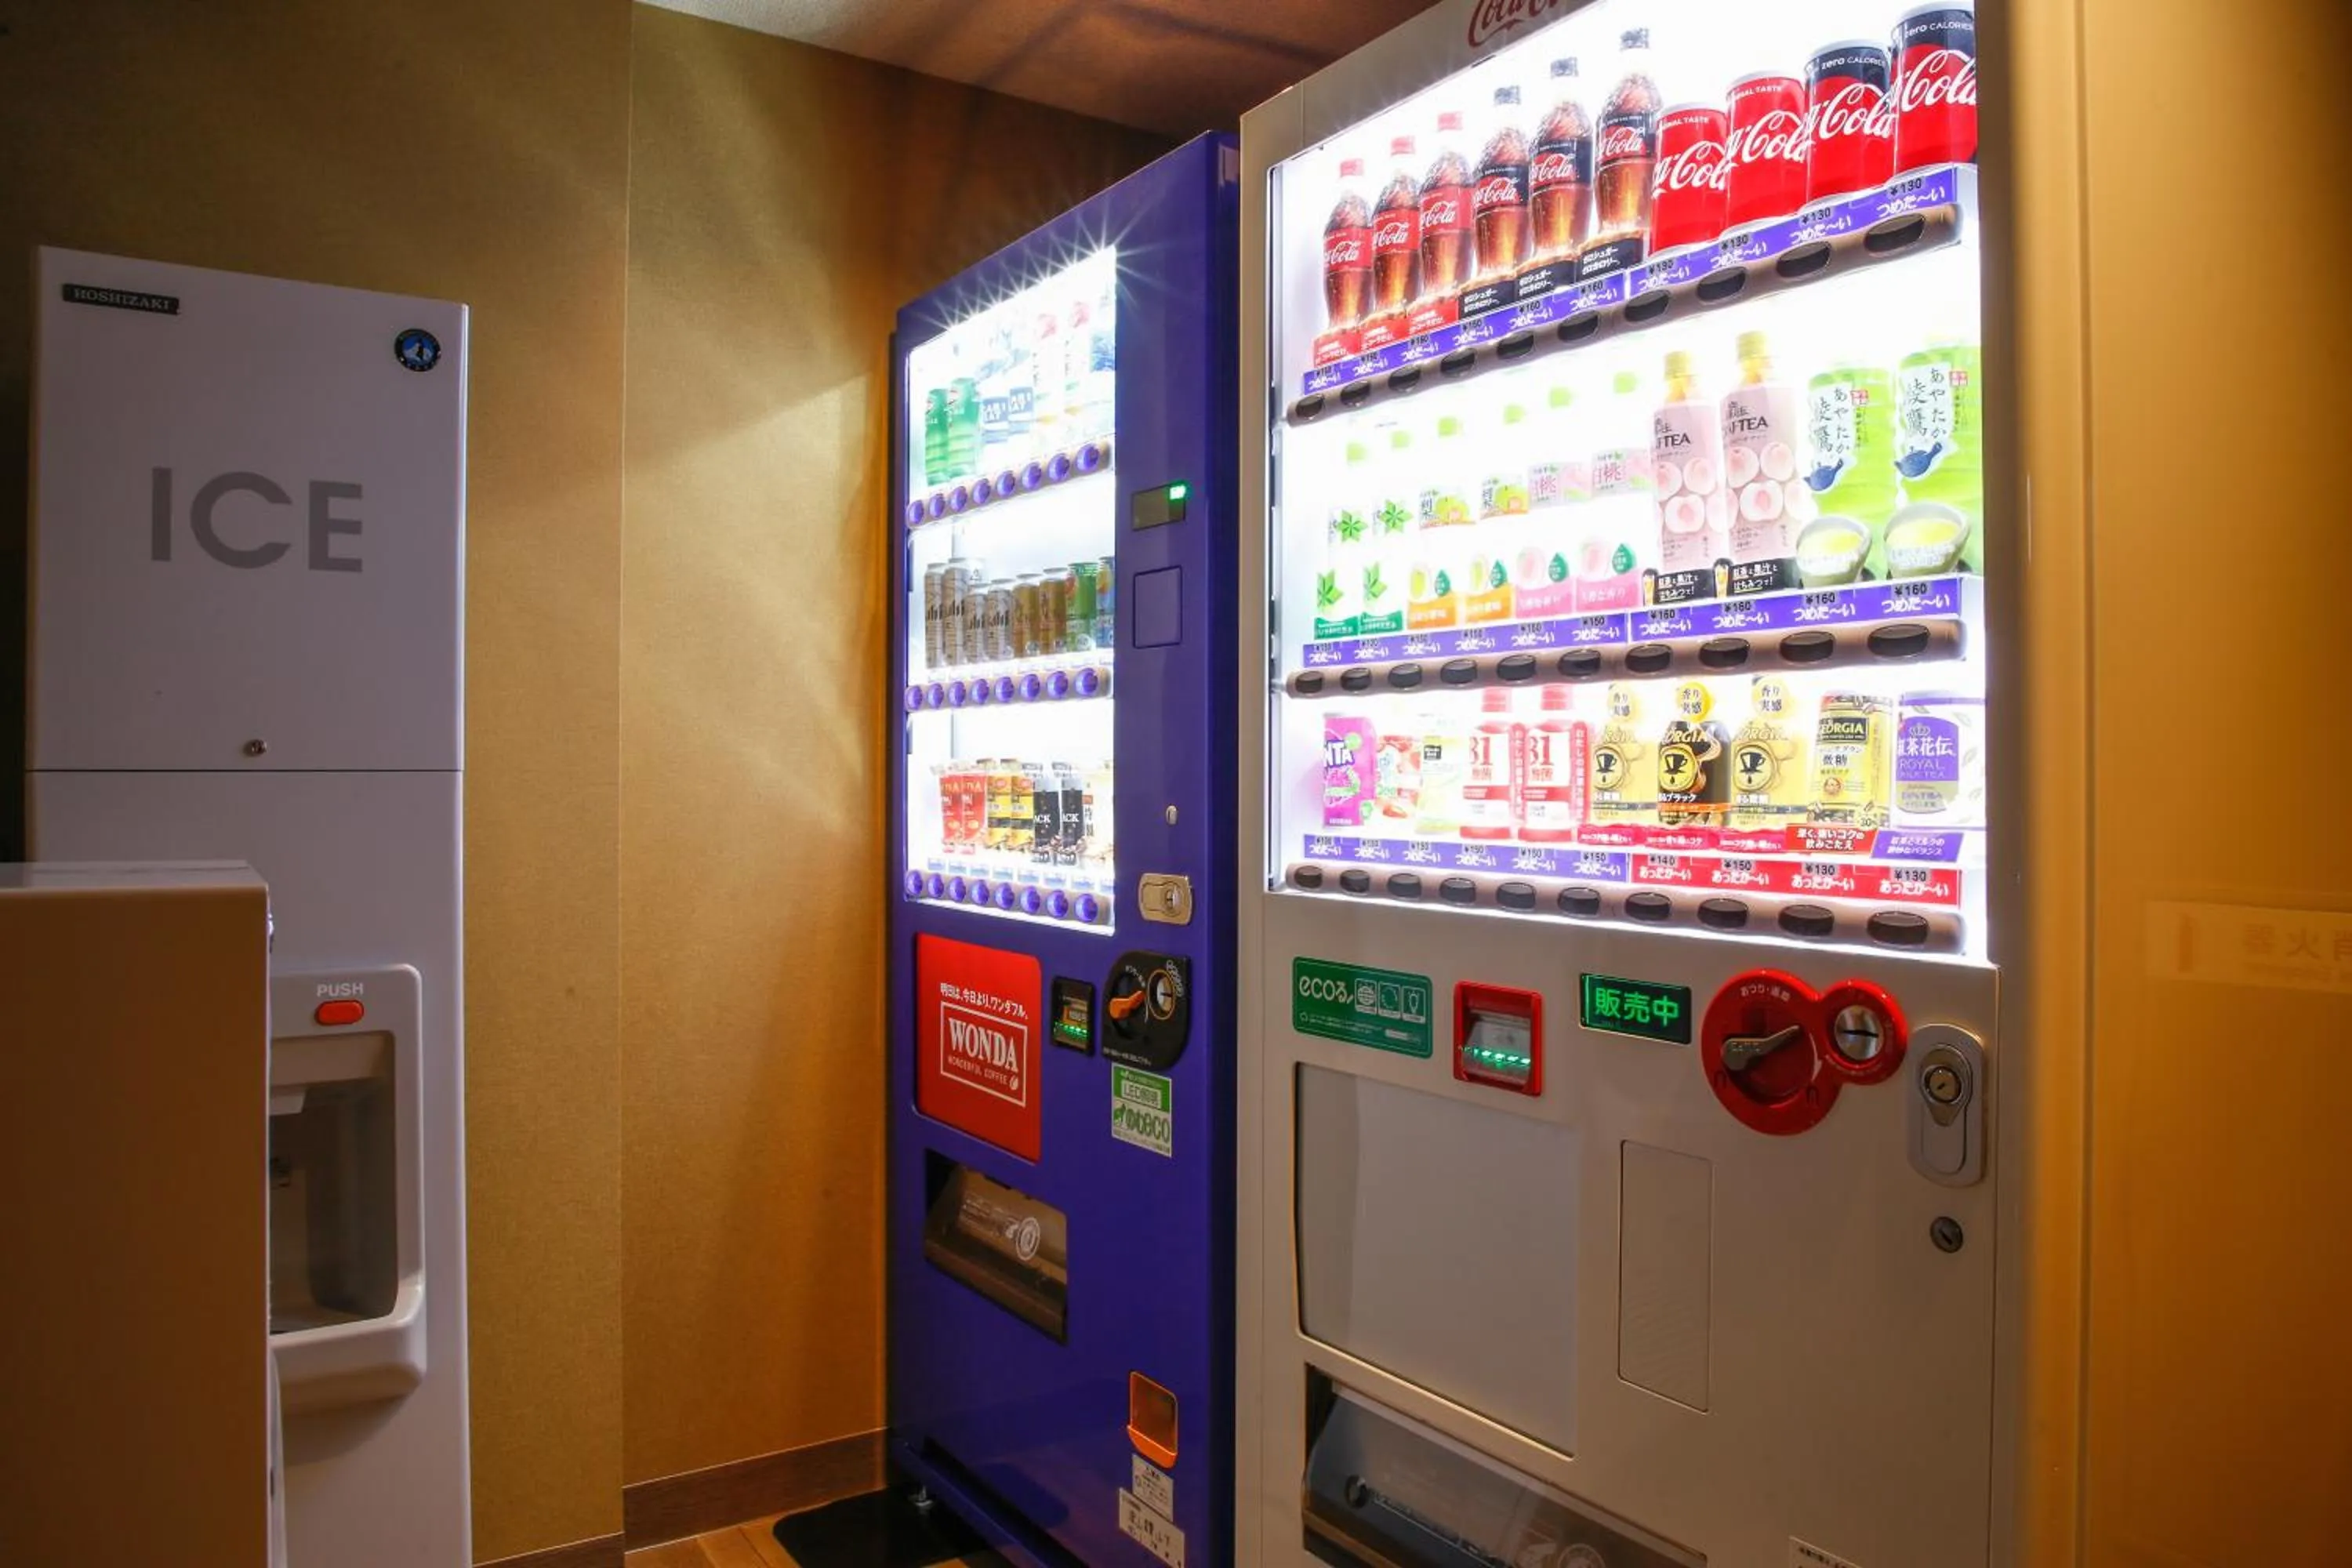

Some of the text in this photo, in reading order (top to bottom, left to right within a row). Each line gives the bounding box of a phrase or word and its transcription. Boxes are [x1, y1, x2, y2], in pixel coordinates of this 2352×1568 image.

[1890, 178, 1922, 195] ¥130
[1802, 208, 1831, 223] ¥130
[74, 288, 169, 310] HOSHIZAKI
[151, 467, 362, 572] ICE
[1894, 583, 1928, 596] ¥160
[1806, 592, 1835, 604] ¥160
[1806, 864, 1835, 876] ¥130
[1894, 869, 1927, 882] ¥130
[316, 982, 365, 997] PUSH
[1595, 987, 1679, 1028] 販売中
[948, 1017, 1018, 1073] WONDA
